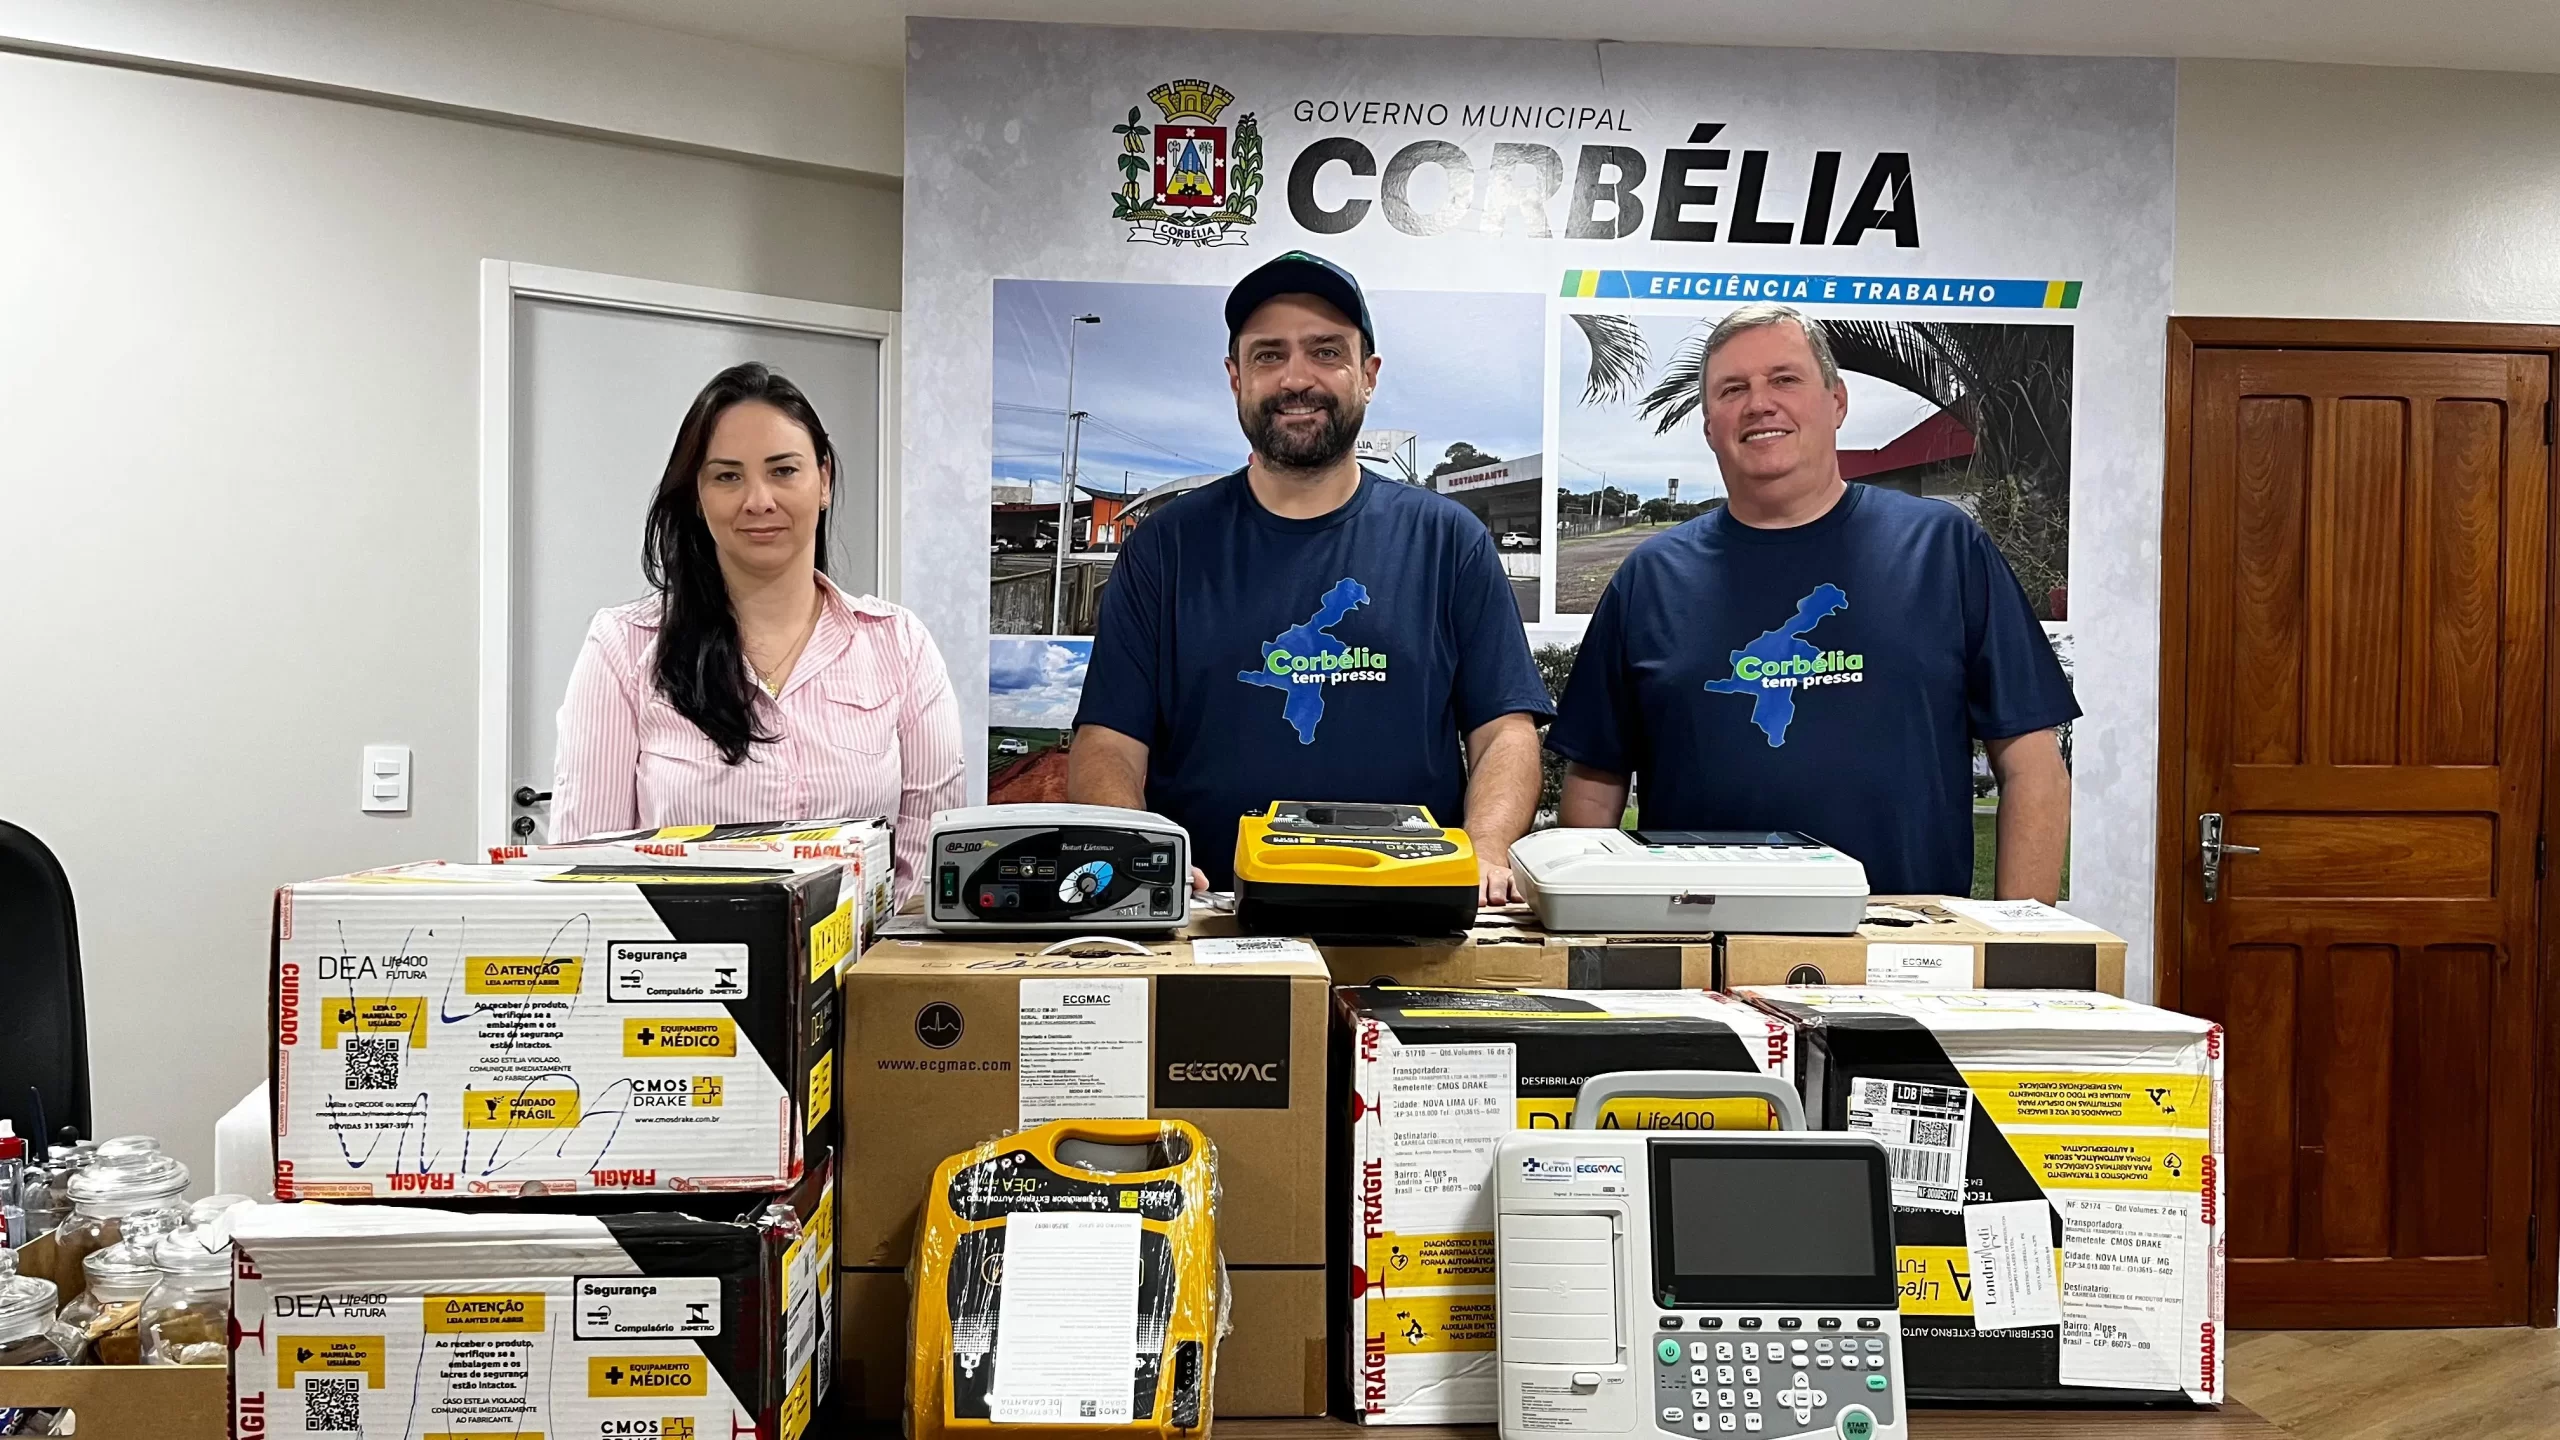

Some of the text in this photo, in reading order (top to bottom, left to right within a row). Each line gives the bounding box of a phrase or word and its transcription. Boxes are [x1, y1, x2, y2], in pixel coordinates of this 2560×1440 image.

[1294, 100, 1632, 131] GOVERNO MUNICIPAL
[1287, 123, 1920, 248] CORBÉLIA
[1161, 225, 1215, 238] CORBÉLIA
[1650, 275, 1995, 302] EFICIÊNCIA E TRABALHO
[1449, 468, 1508, 487] RESTAURANTE
[1267, 647, 1387, 675] Corbélia
[1736, 651, 1863, 680] Corbélia
[1292, 671, 1386, 685] tem pressa
[1762, 672, 1863, 689] tem pressa
[946, 842, 982, 853] BP-100
[618, 949, 687, 962] Segurança
[1903, 958, 1942, 966] ECGMAC
[319, 956, 428, 980] DEA Life400
[501, 963, 559, 976] ATENÇÃO
[386, 971, 427, 979] FUTURA
[647, 988, 703, 996] Compulsório
[281, 963, 300, 1046] CUIDADO
[1063, 995, 1111, 1003] ECGMAC
[661, 1033, 720, 1047] MÉDICO
[878, 1060, 1011, 1073] www.ecgmac.com
[1169, 1063, 1277, 1081] ECGMAC
[1393, 1067, 1450, 1075] Transportadora:
[632, 1079, 687, 1092] CMOS
[1898, 1086, 1917, 1100] LDB
[634, 1096, 687, 1106] DRAKE
[510, 1108, 555, 1119] FRÁGIL
[1636, 1112, 1715, 1130] Life400
[1424, 1169, 1447, 1178] Alpes
[1541, 1162, 1571, 1172] Ceron
[1577, 1165, 1622, 1173] ECGMAC
[2056, 1163, 2094, 1171] CARDÍACAS
[386, 1173, 454, 1195] FRÁGIL
[590, 1169, 656, 1190] FRÁGIL
[1002, 1178, 1036, 1193] DEA
[2201, 1154, 2217, 1226] CUIDADO
[1358, 1158, 1382, 1239] FRÁGIL
[2081, 1202, 2101, 1210] 52174
[2067, 1218, 2124, 1229] Transportadora:
[1424, 1239, 1471, 1248] DIAGNÓSTICO
[2066, 1235, 2106, 1245] Remetente:
[2136, 1240, 2162, 1248] DRAKE
[1440, 1248, 1477, 1256] ARRITMIAS
[2065, 1252, 2093, 1261] Cidade:
[2096, 1254, 2117, 1262] NOVA
[584, 1284, 657, 1297] Segurança
[275, 1293, 387, 1317] DEA Life400
[462, 1300, 524, 1314] ATENÇÃO
[344, 1309, 386, 1318] FUTURA
[615, 1324, 674, 1333] Compulsório
[1931, 1328, 2054, 1338] DESFIBRILADOR EXTERNO
[2063, 1321, 2117, 1333] Bairro: Alpes
[2063, 1330, 2092, 1338] Londrina
[2063, 1338, 2082, 1346] Brasil
[2201, 1322, 2216, 1394] CUIDADO
[449, 1361, 500, 1369] embalagem
[630, 1372, 691, 1386] MÉDICO
[1360, 1331, 1386, 1414] FRÁGIL
[1695, 1392, 1701, 1400] 7
[601, 1421, 658, 1434] CMOS
